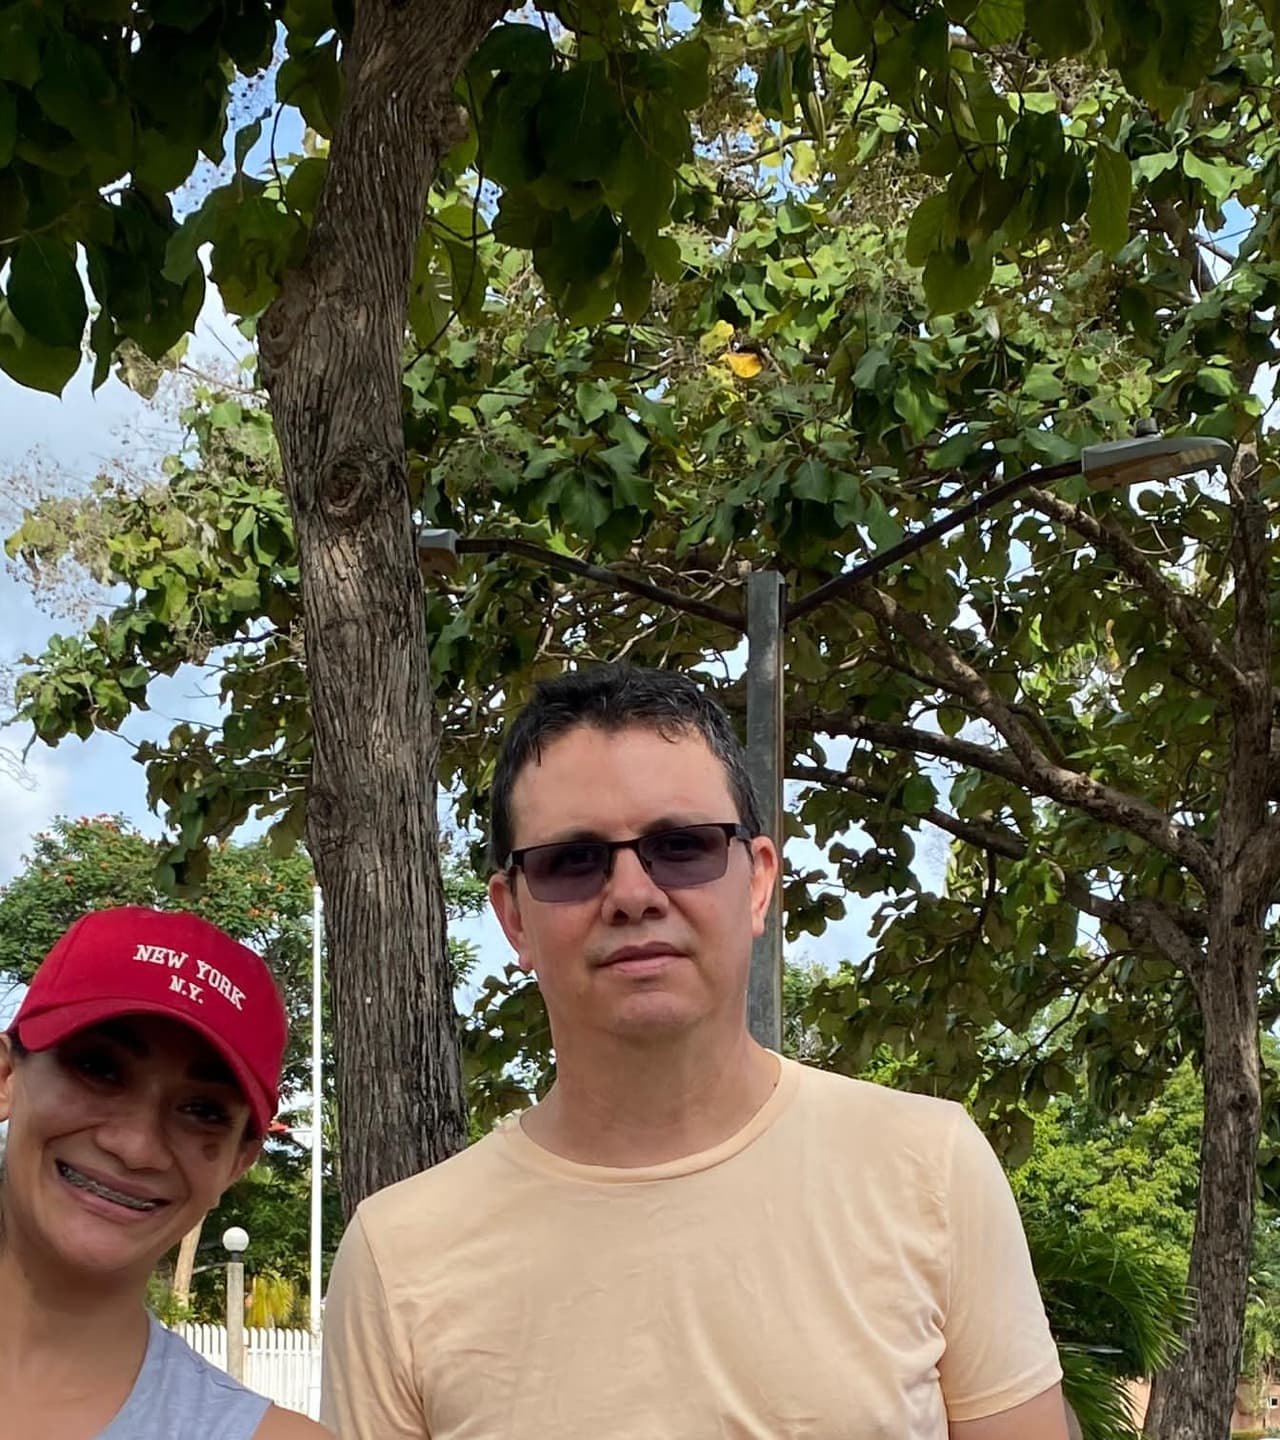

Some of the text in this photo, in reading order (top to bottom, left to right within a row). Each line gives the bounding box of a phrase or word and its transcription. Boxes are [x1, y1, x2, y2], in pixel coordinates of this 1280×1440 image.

[133, 944, 247, 1011] NEW YORK
[169, 974, 204, 1004] N.Y.
